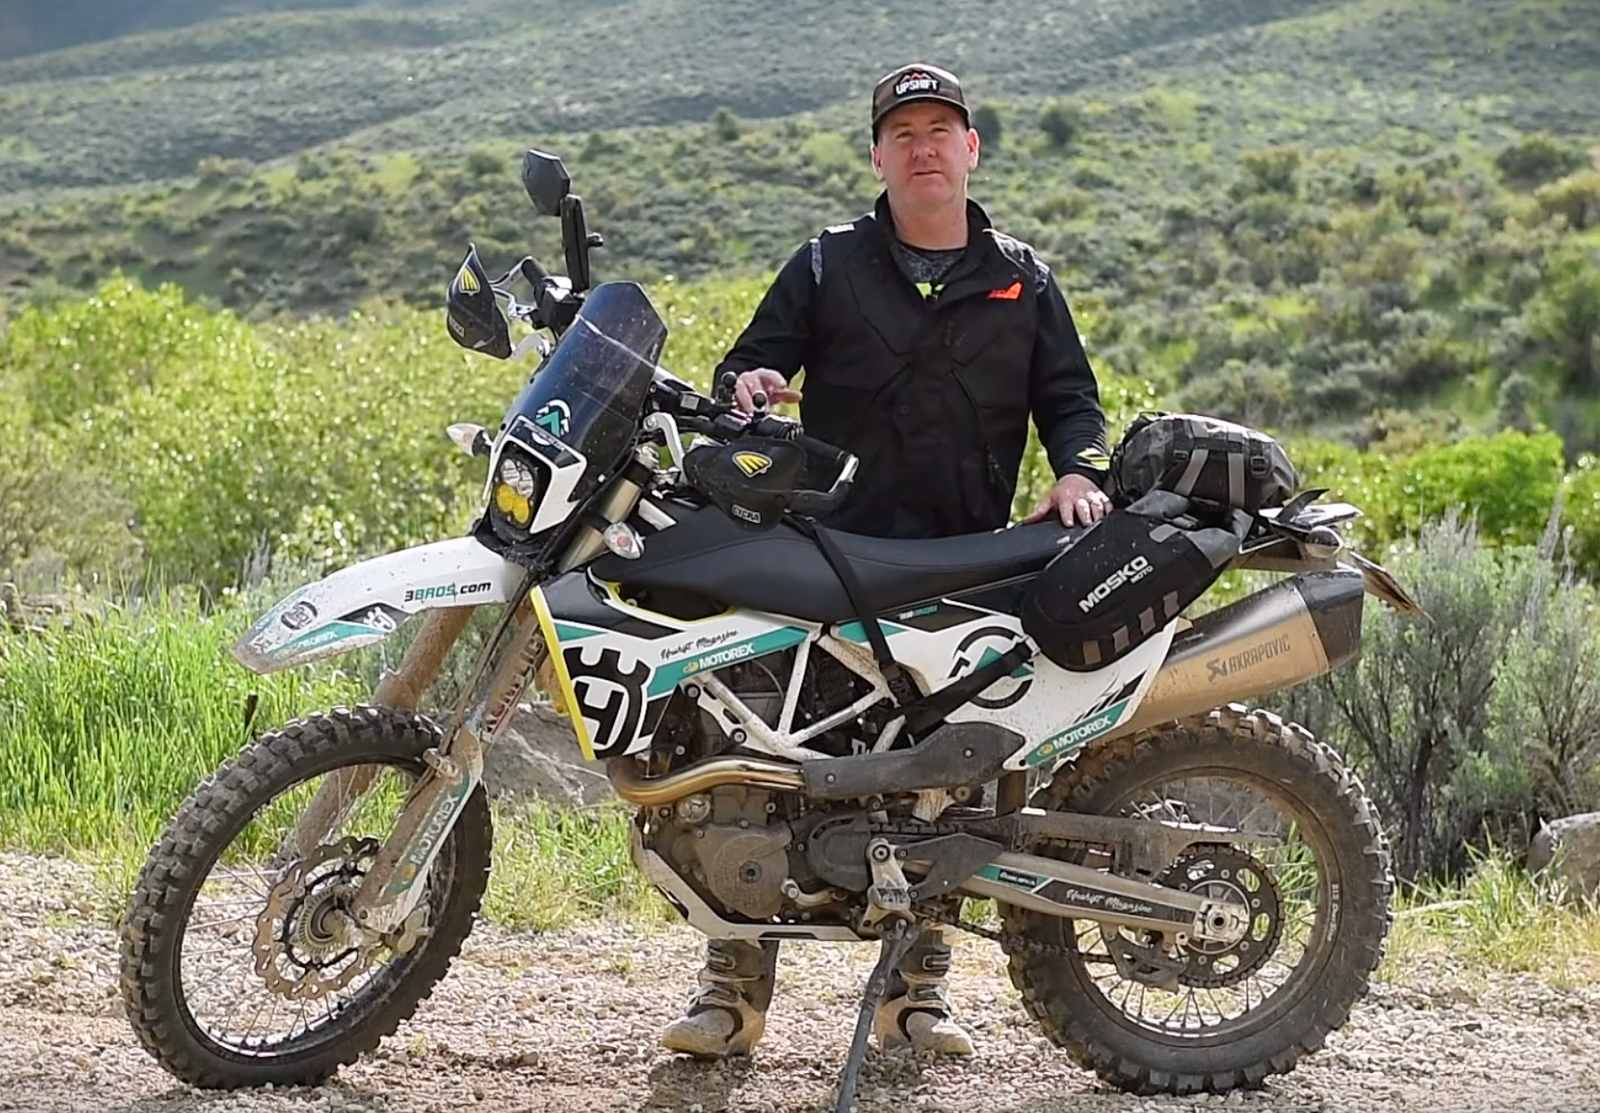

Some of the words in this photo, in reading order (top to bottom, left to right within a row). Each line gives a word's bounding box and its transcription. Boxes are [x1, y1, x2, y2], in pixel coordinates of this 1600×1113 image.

[895, 80, 938, 94] UPSHIFT
[1079, 556, 1148, 613] MOSKO
[1130, 565, 1154, 583] MOTO
[404, 582, 492, 602] 3BROS.com
[699, 643, 755, 669] MOTOREX
[1053, 715, 1112, 749] MOTOREX
